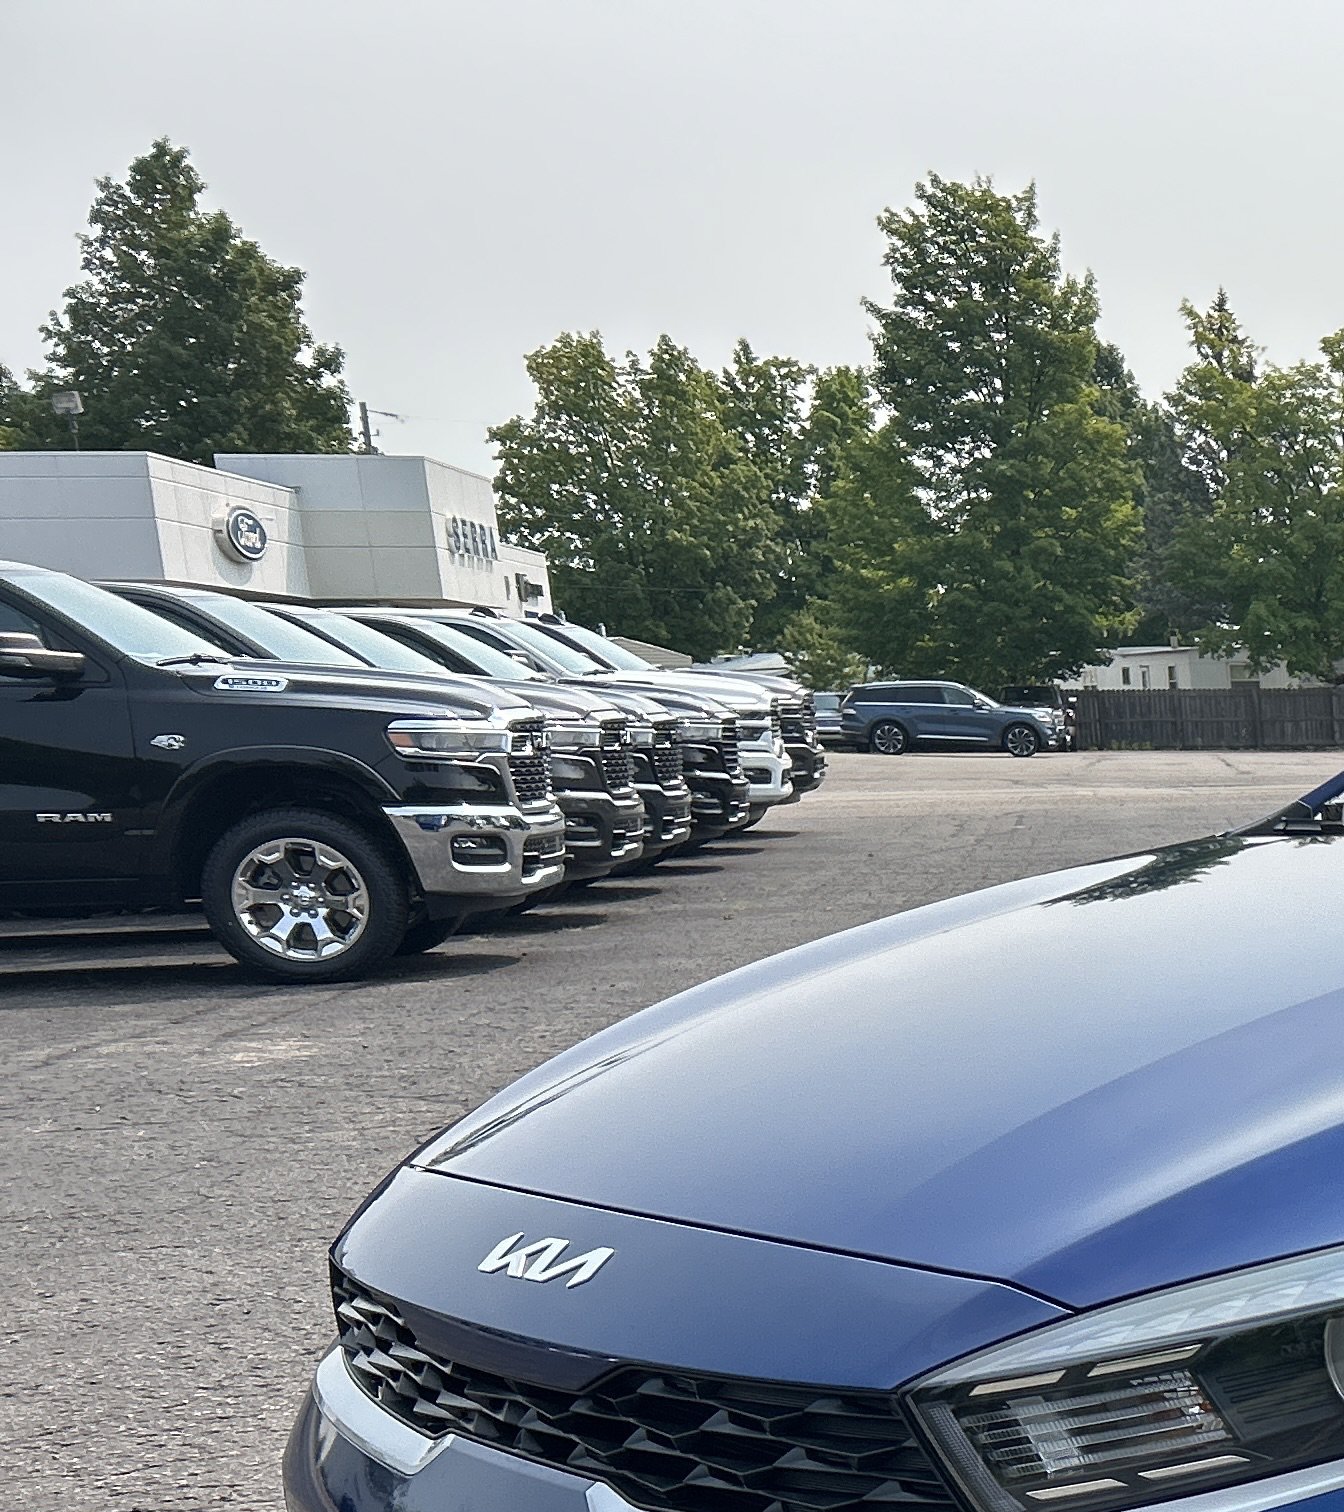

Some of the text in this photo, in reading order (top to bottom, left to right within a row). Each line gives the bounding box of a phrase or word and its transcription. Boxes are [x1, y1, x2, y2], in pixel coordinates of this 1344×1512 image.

[238, 515, 262, 548] Ford
[451, 515, 498, 561] SERRA
[36, 812, 112, 823] RAM
